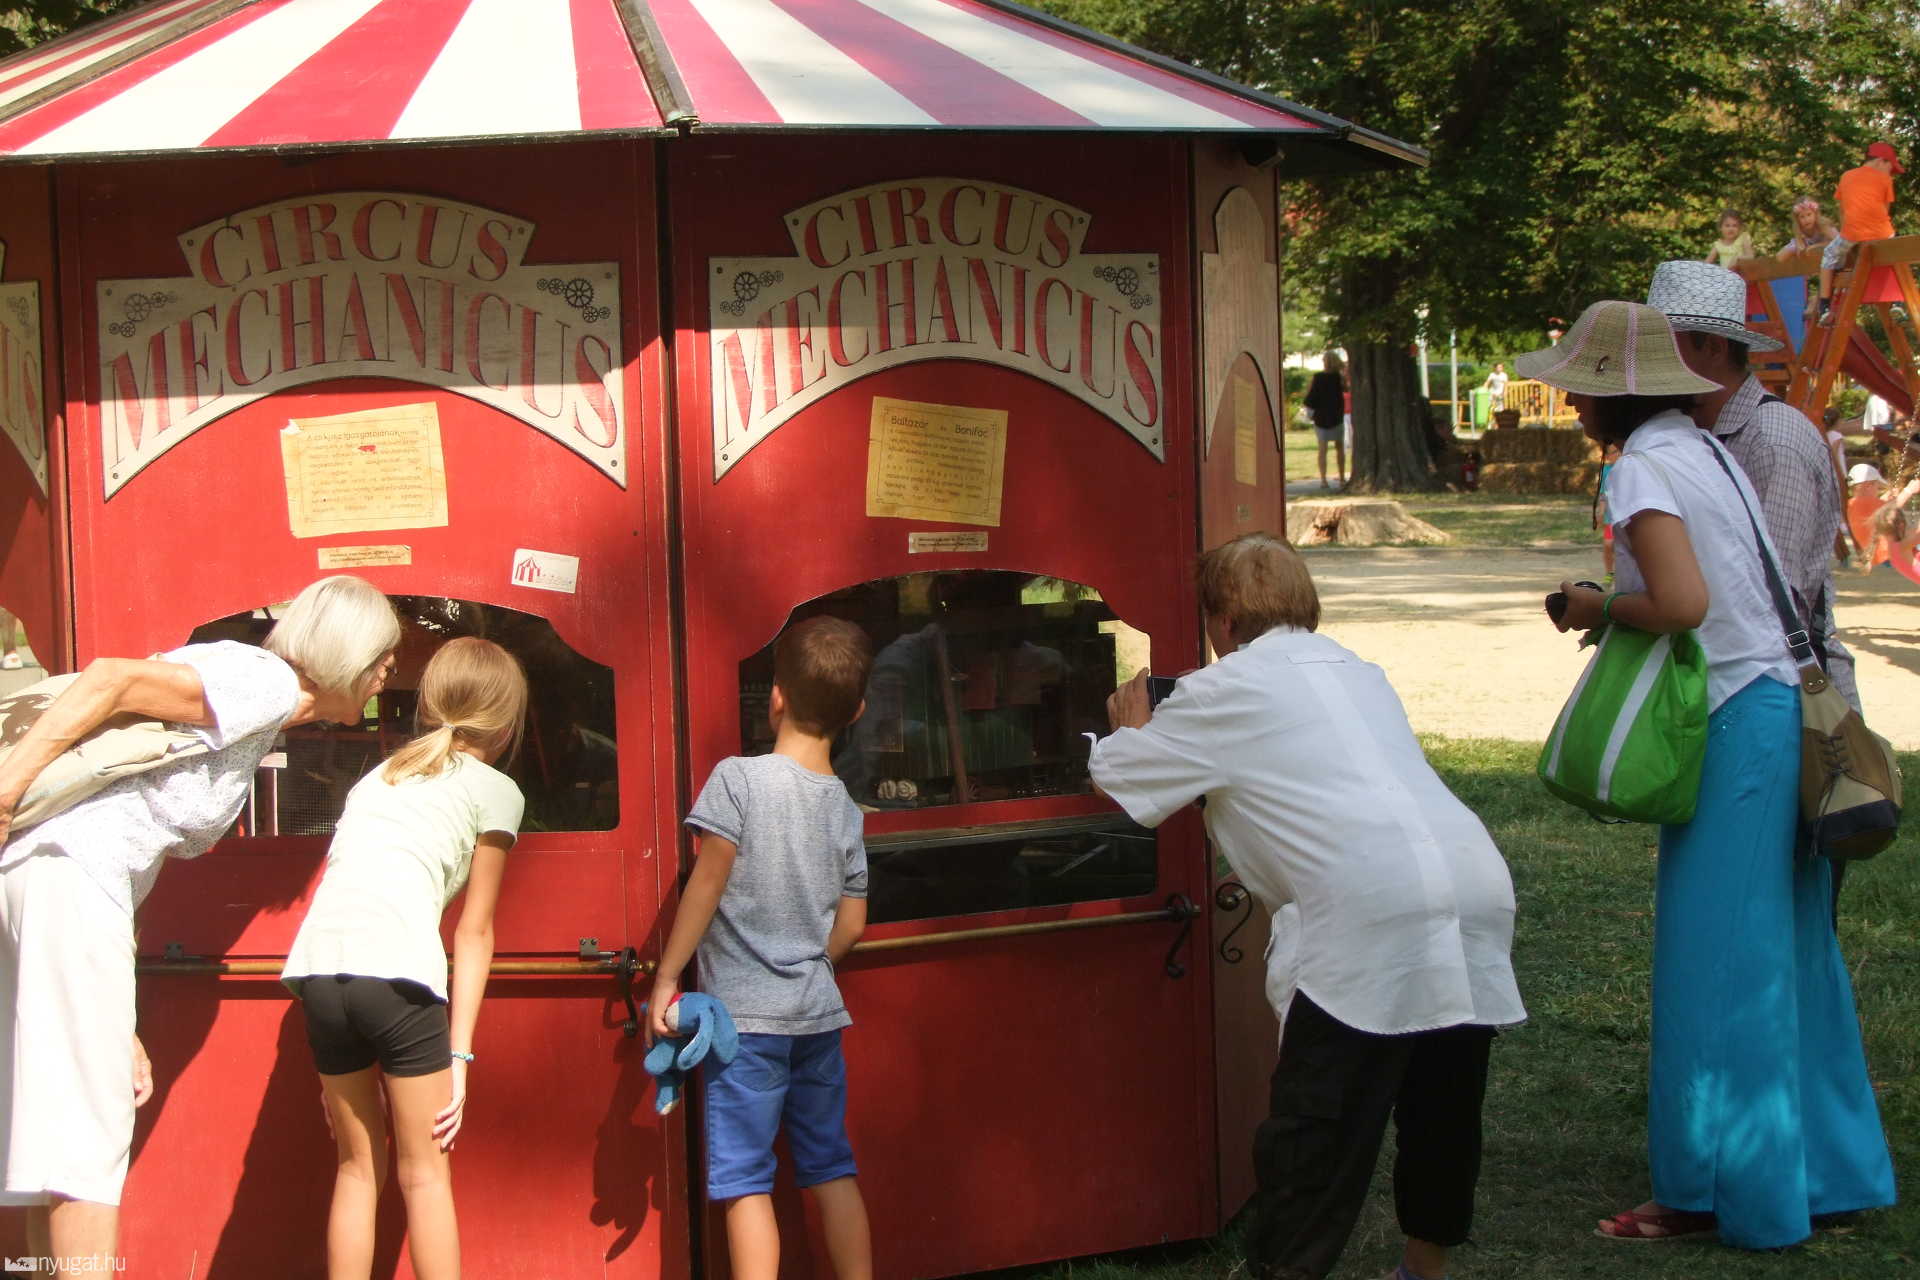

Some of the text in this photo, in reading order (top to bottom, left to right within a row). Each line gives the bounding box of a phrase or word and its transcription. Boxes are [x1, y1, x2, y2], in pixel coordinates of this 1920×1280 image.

[200, 199, 513, 288] CIRCUS
[803, 185, 1074, 269] CIRCUS
[104, 271, 618, 469] MECHANICUS
[716, 255, 1158, 451] MECHANICUS
